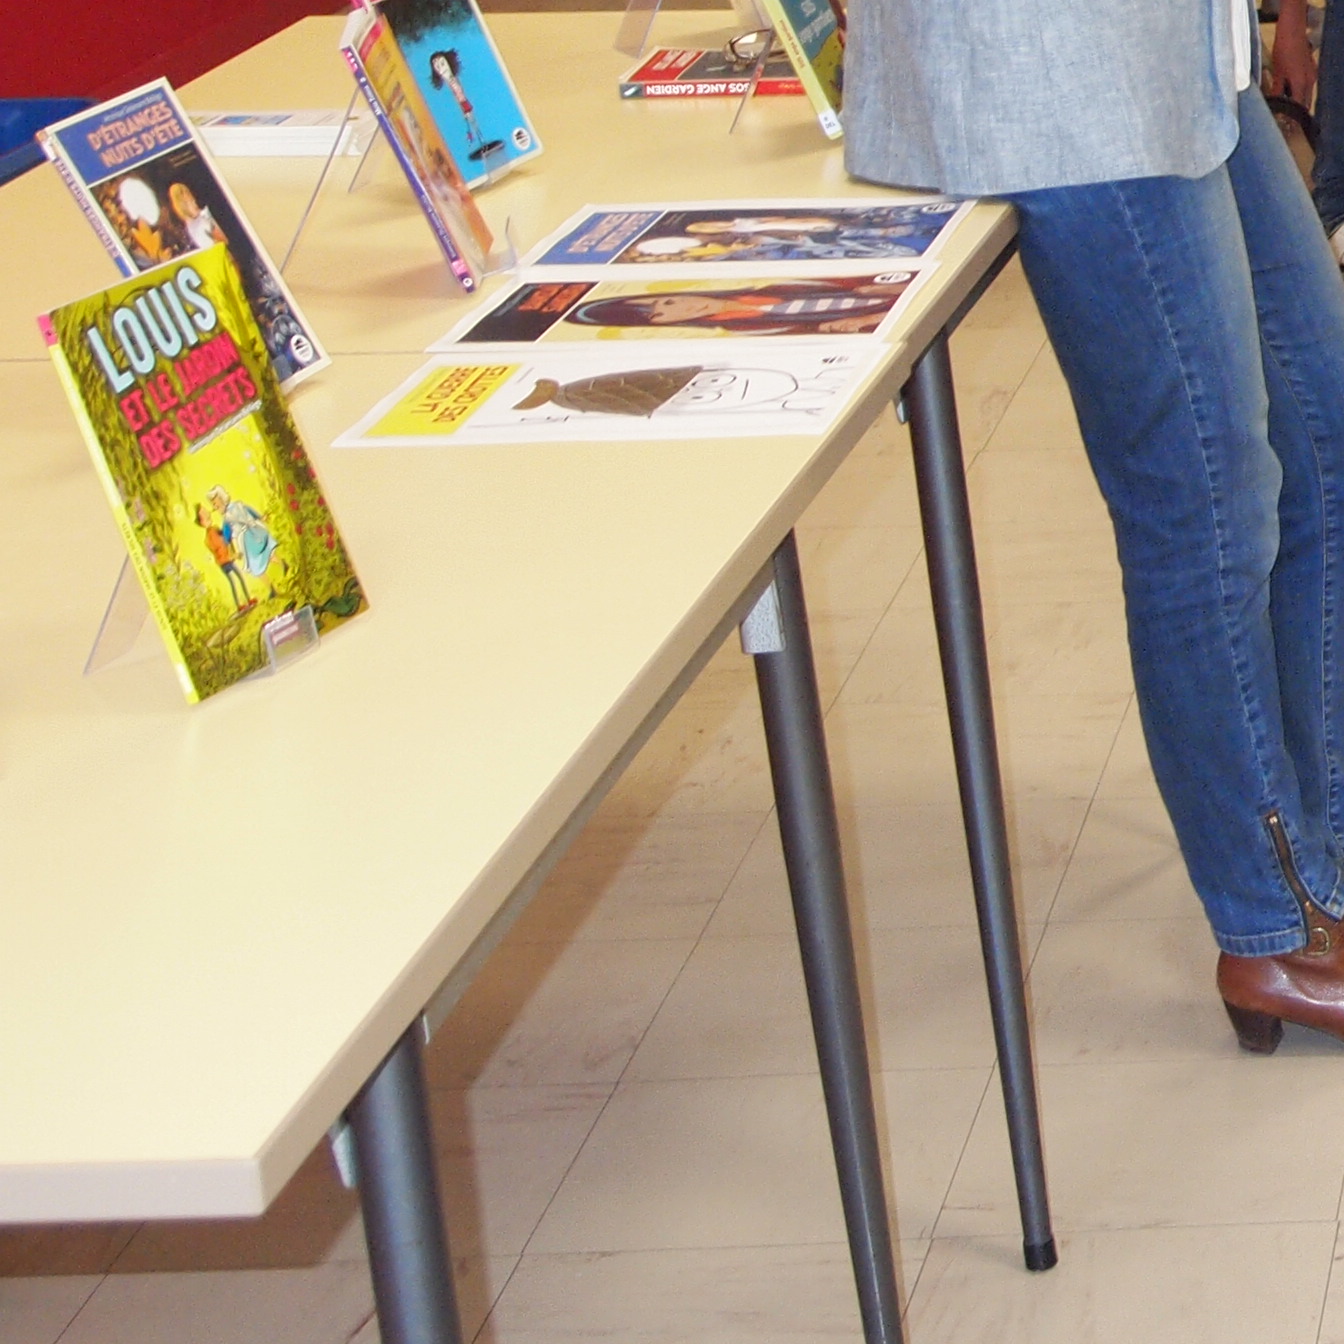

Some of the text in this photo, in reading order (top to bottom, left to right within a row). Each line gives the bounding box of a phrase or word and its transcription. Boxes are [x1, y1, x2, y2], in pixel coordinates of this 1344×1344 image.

[646, 84, 693, 95] GARDIEN
[695, 82, 726, 94] ANGE
[101, 136, 145, 168] NUITS
[87, 267, 217, 393] LOUIS
[119, 388, 150, 432] ET
[147, 373, 179, 413] LE
[174, 332, 240, 398] JARDIN
[138, 419, 181, 468] DES
[176, 365, 257, 441] SECRETS
